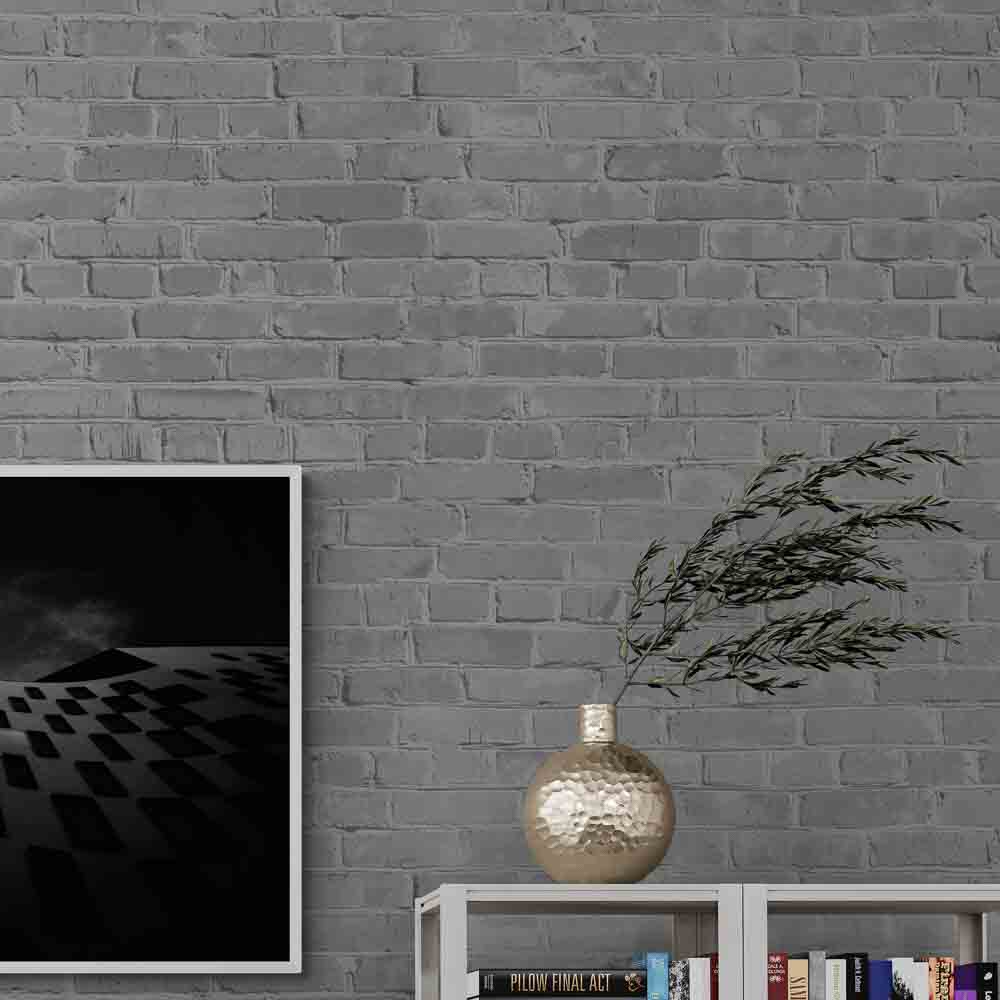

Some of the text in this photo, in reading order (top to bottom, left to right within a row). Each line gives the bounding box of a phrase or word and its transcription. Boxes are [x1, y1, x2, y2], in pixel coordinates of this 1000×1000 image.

[511, 974, 547, 991] PILOW
[552, 974, 586, 991] FINAL
[589, 974, 611, 991] ACT
